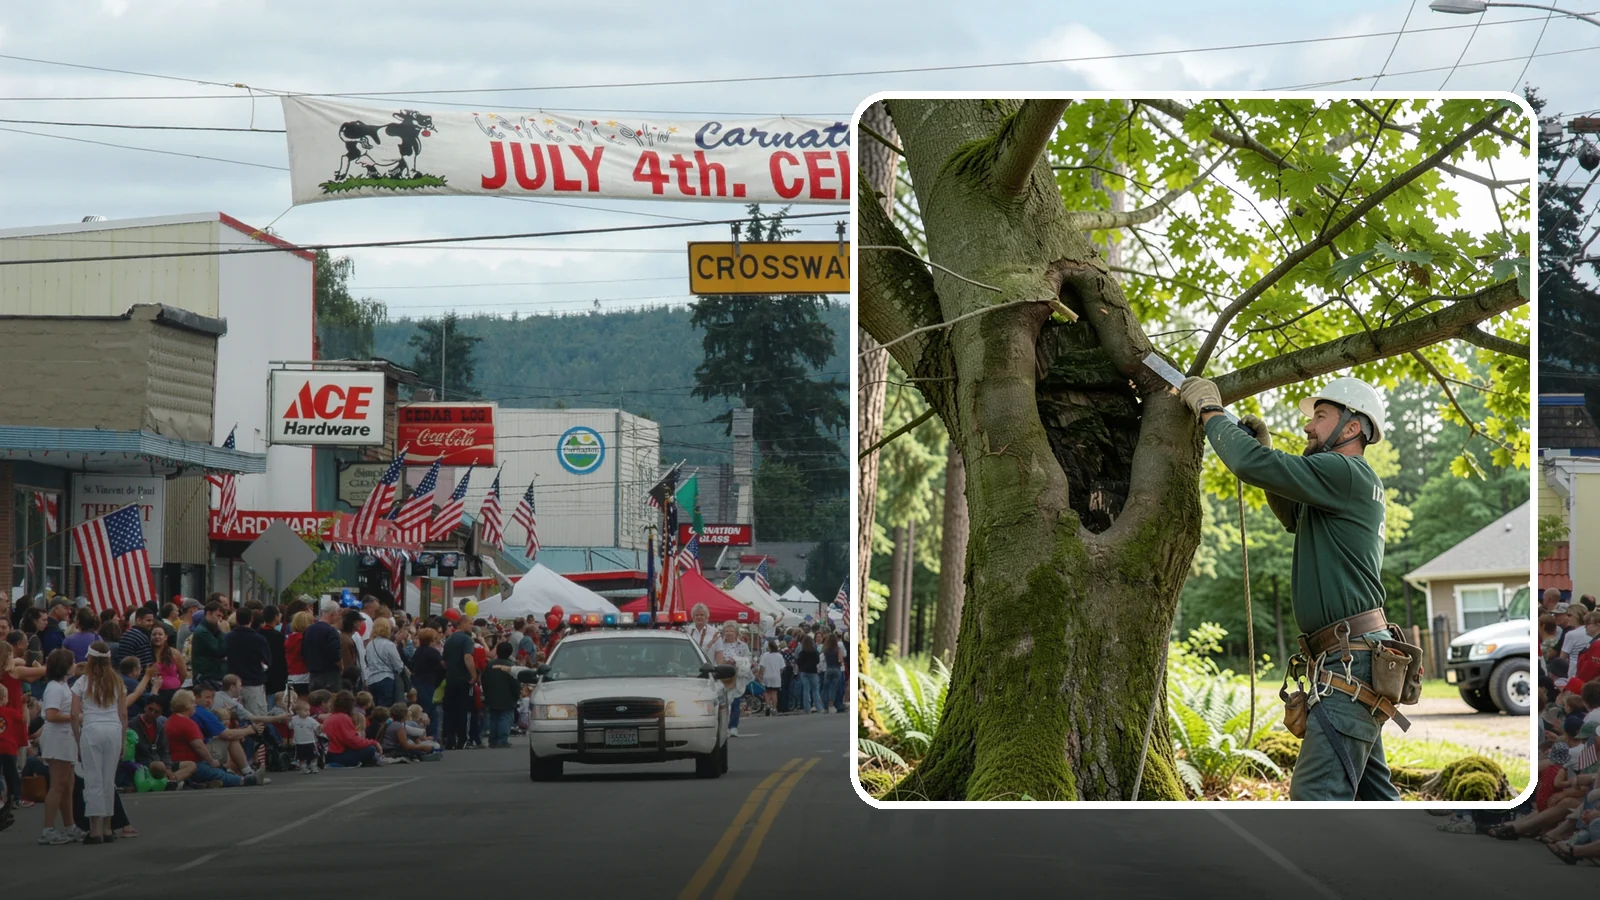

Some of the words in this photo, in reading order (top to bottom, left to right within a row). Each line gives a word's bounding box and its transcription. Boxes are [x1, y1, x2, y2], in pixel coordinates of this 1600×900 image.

[481, 140, 605, 193] JULY
[633, 150, 746, 197] 4th.
[697, 254, 850, 280] CROSSWA
[283, 380, 373, 420] ACE
[405, 409, 452, 422] CEDAR
[461, 409, 485, 421] LOG
[283, 421, 370, 436] Hardware
[416, 428, 477, 447] Coca-Cola
[83, 485, 93, 494] St.
[95, 485, 124, 494] Vincent
[126, 486, 135, 494] de
[138, 486, 155, 495] Paul
[81, 503, 153, 522] THT
[688, 526, 741, 535] CRNATION
[699, 535, 730, 543] GLASS
